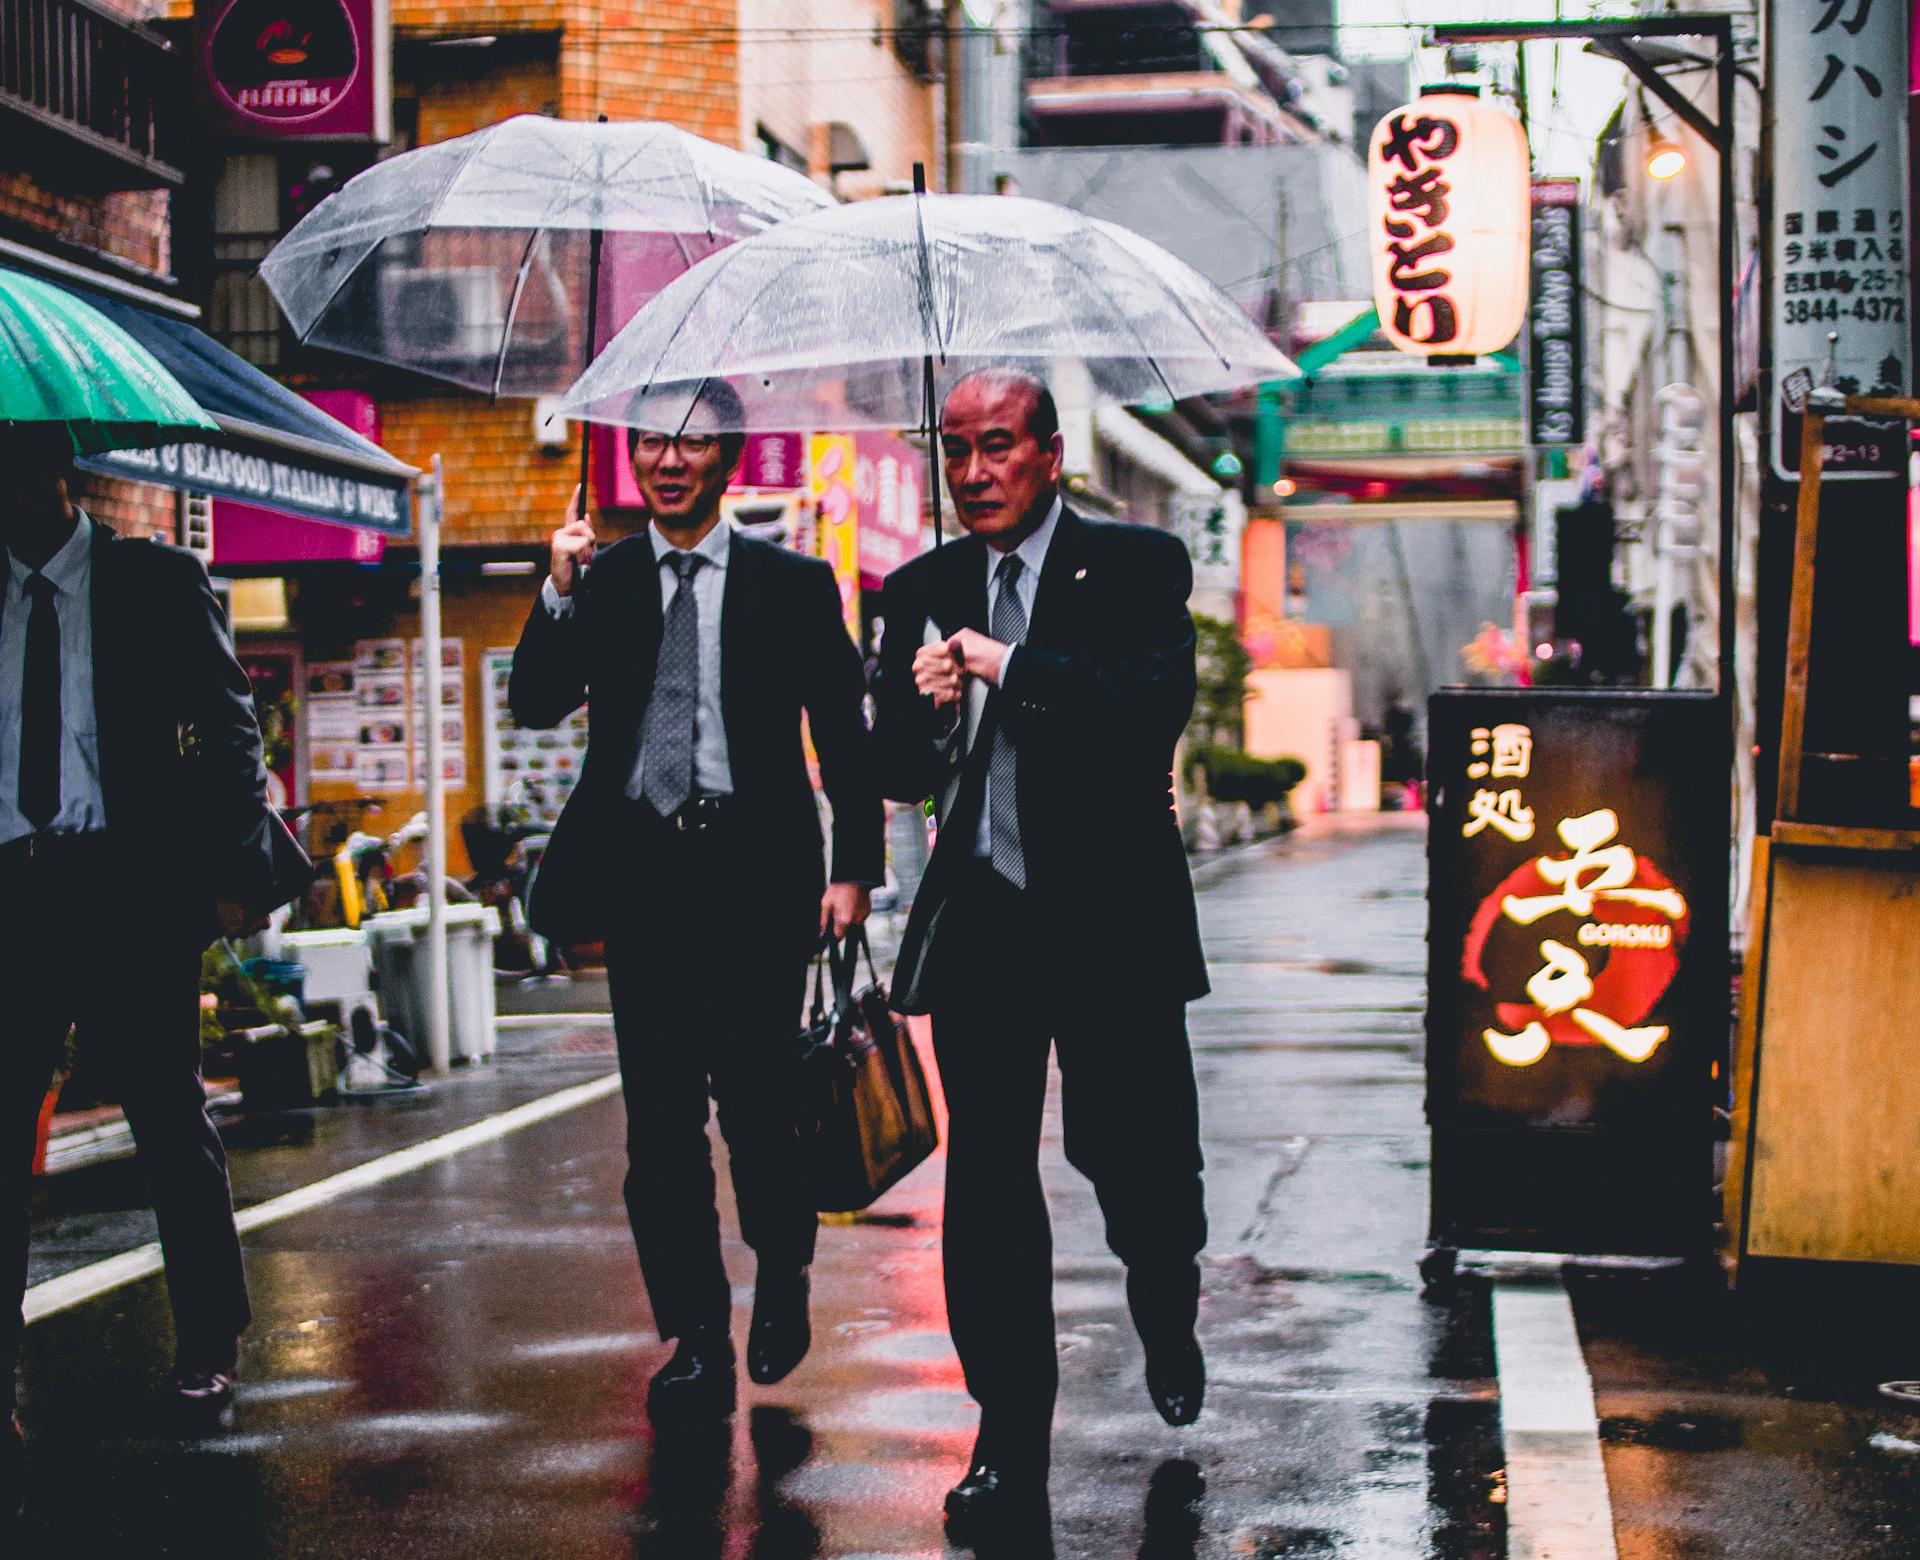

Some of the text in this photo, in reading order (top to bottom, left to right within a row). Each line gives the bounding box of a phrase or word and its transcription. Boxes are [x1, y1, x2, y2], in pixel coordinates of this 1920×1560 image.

[1381, 113, 1460, 344] やきとり
[1532, 206, 1572, 267] Oasis
[1532, 269, 1574, 337] Tokyo
[1535, 338, 1573, 408] House
[182, 442, 271, 493] SEAFOOD
[271, 461, 341, 508] ITALIAN
[357, 481, 399, 522] WINE
[1462, 723, 1535, 842] 酒処
[1577, 923, 1673, 948] GOROKU
